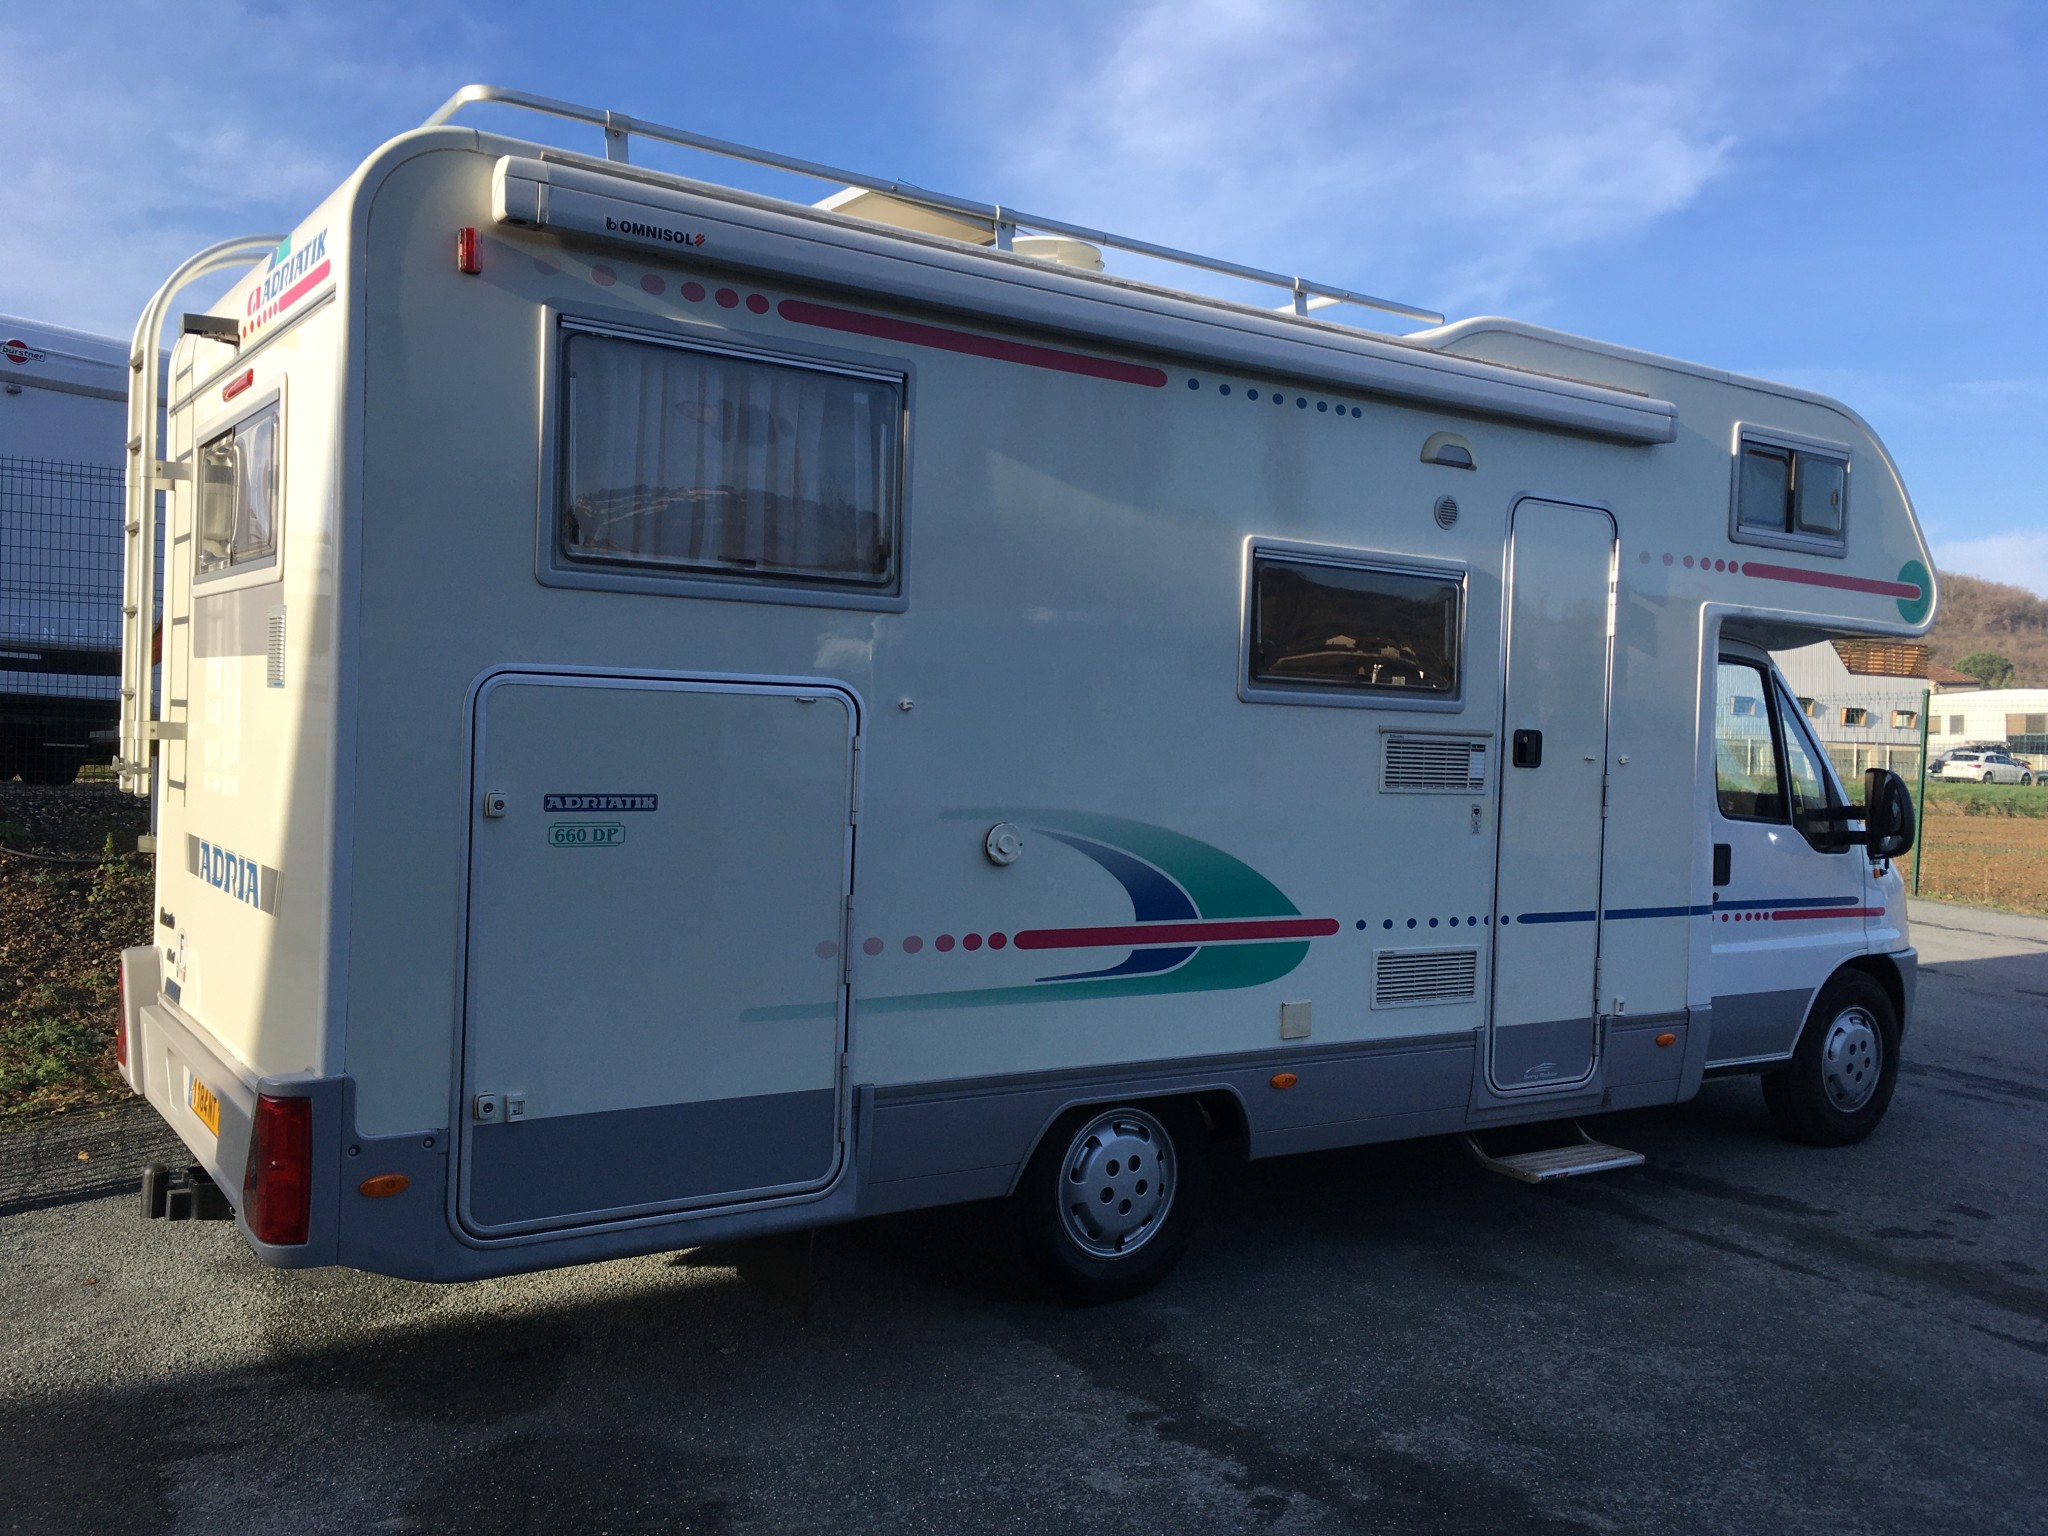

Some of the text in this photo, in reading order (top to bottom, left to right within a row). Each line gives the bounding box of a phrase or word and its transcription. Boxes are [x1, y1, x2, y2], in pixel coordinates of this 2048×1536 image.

[620, 220, 694, 247] OMNISOL
[262, 226, 328, 305] ADRIATIK
[546, 796, 656, 809] ADRIATIK
[554, 828, 619, 843] 660 DP
[200, 838, 260, 910] ADRIA
